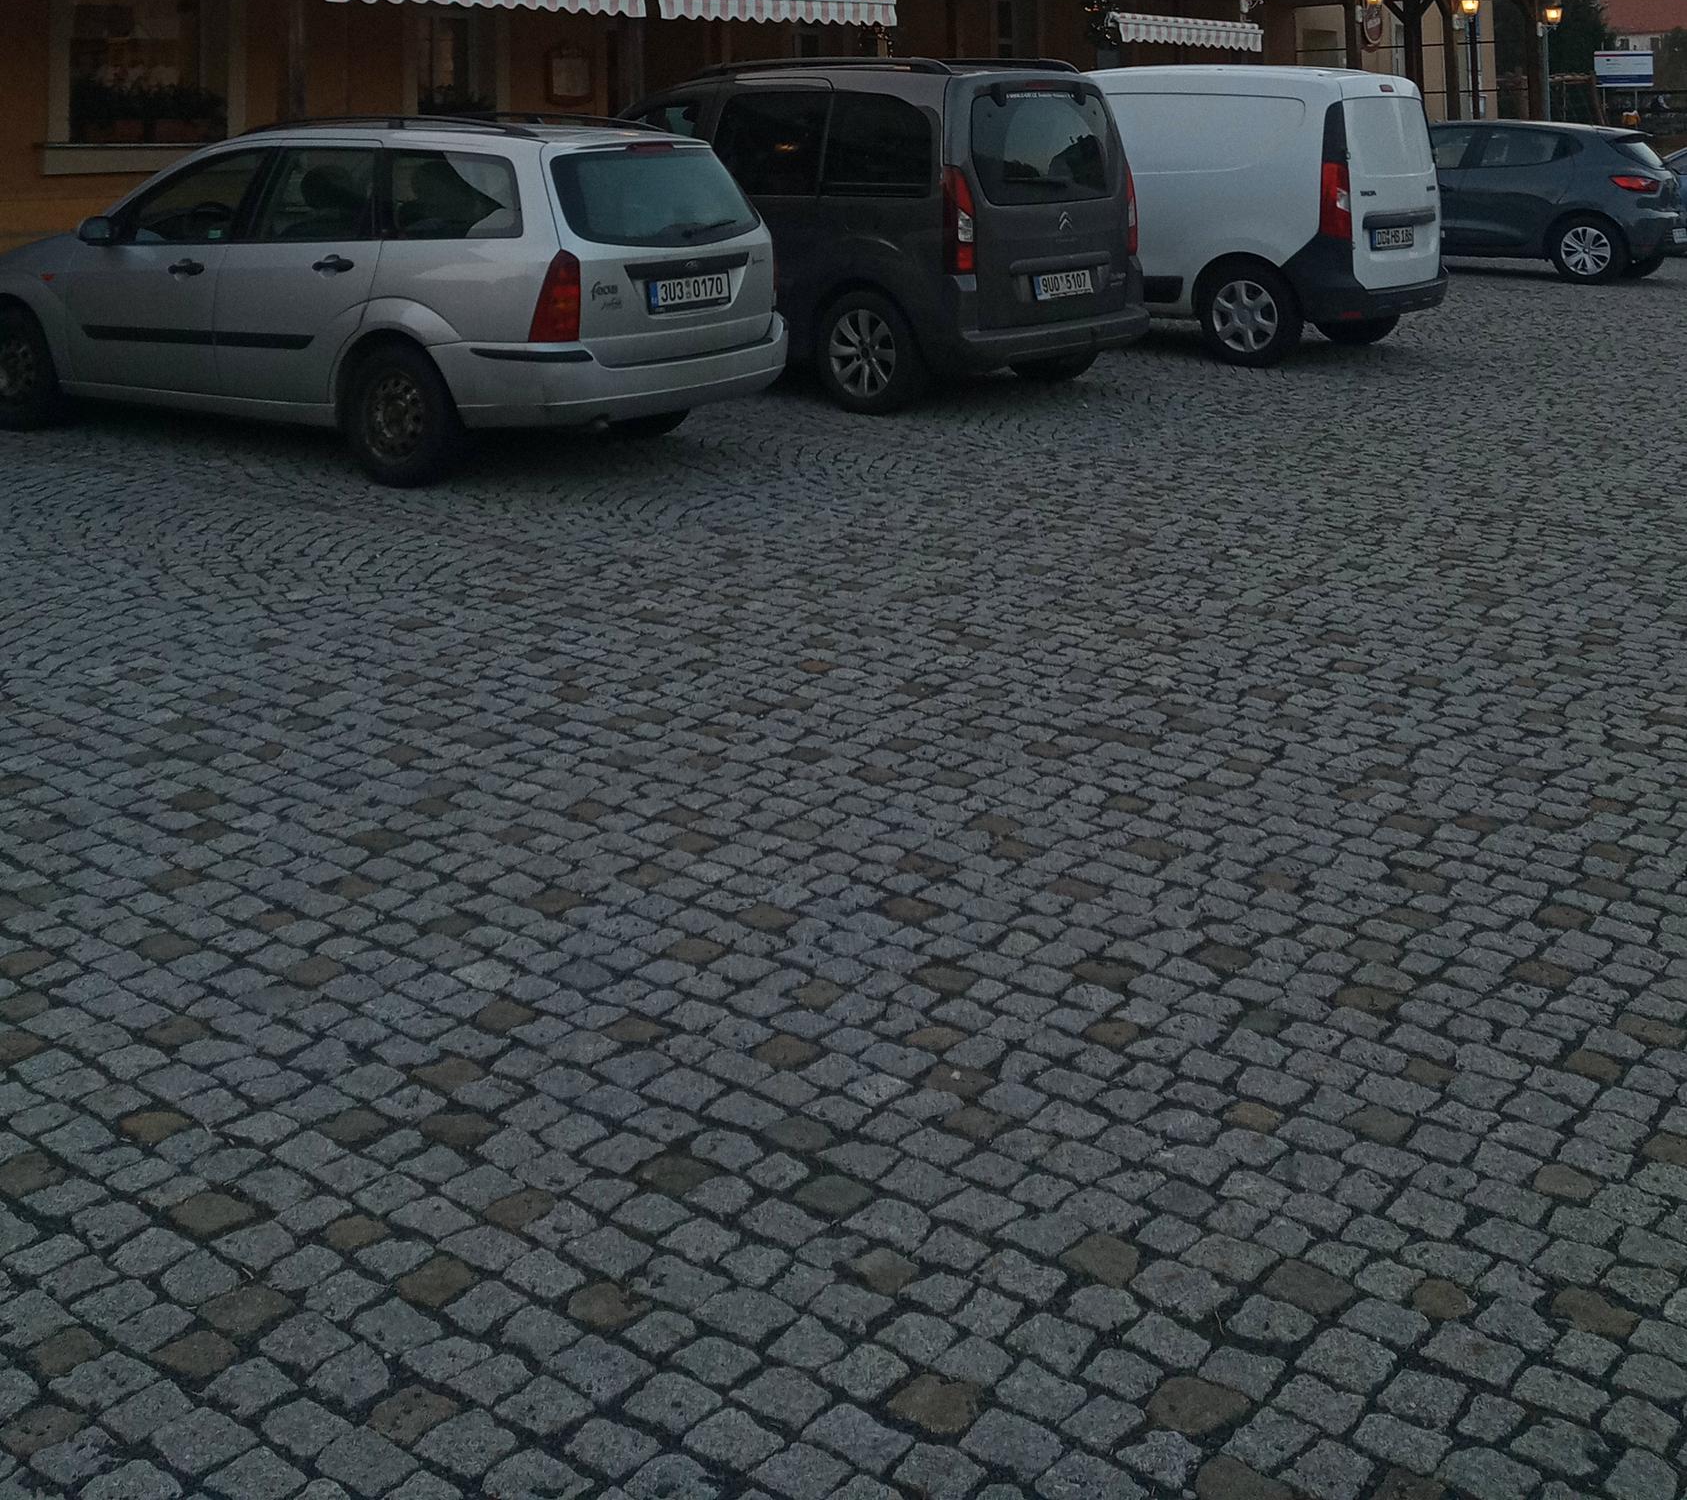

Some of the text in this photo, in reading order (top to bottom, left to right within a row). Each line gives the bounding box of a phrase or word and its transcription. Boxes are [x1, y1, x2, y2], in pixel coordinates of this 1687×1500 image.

[660, 277, 723, 302] 3U3 0170
[1066, 272, 1087, 289] 5107
